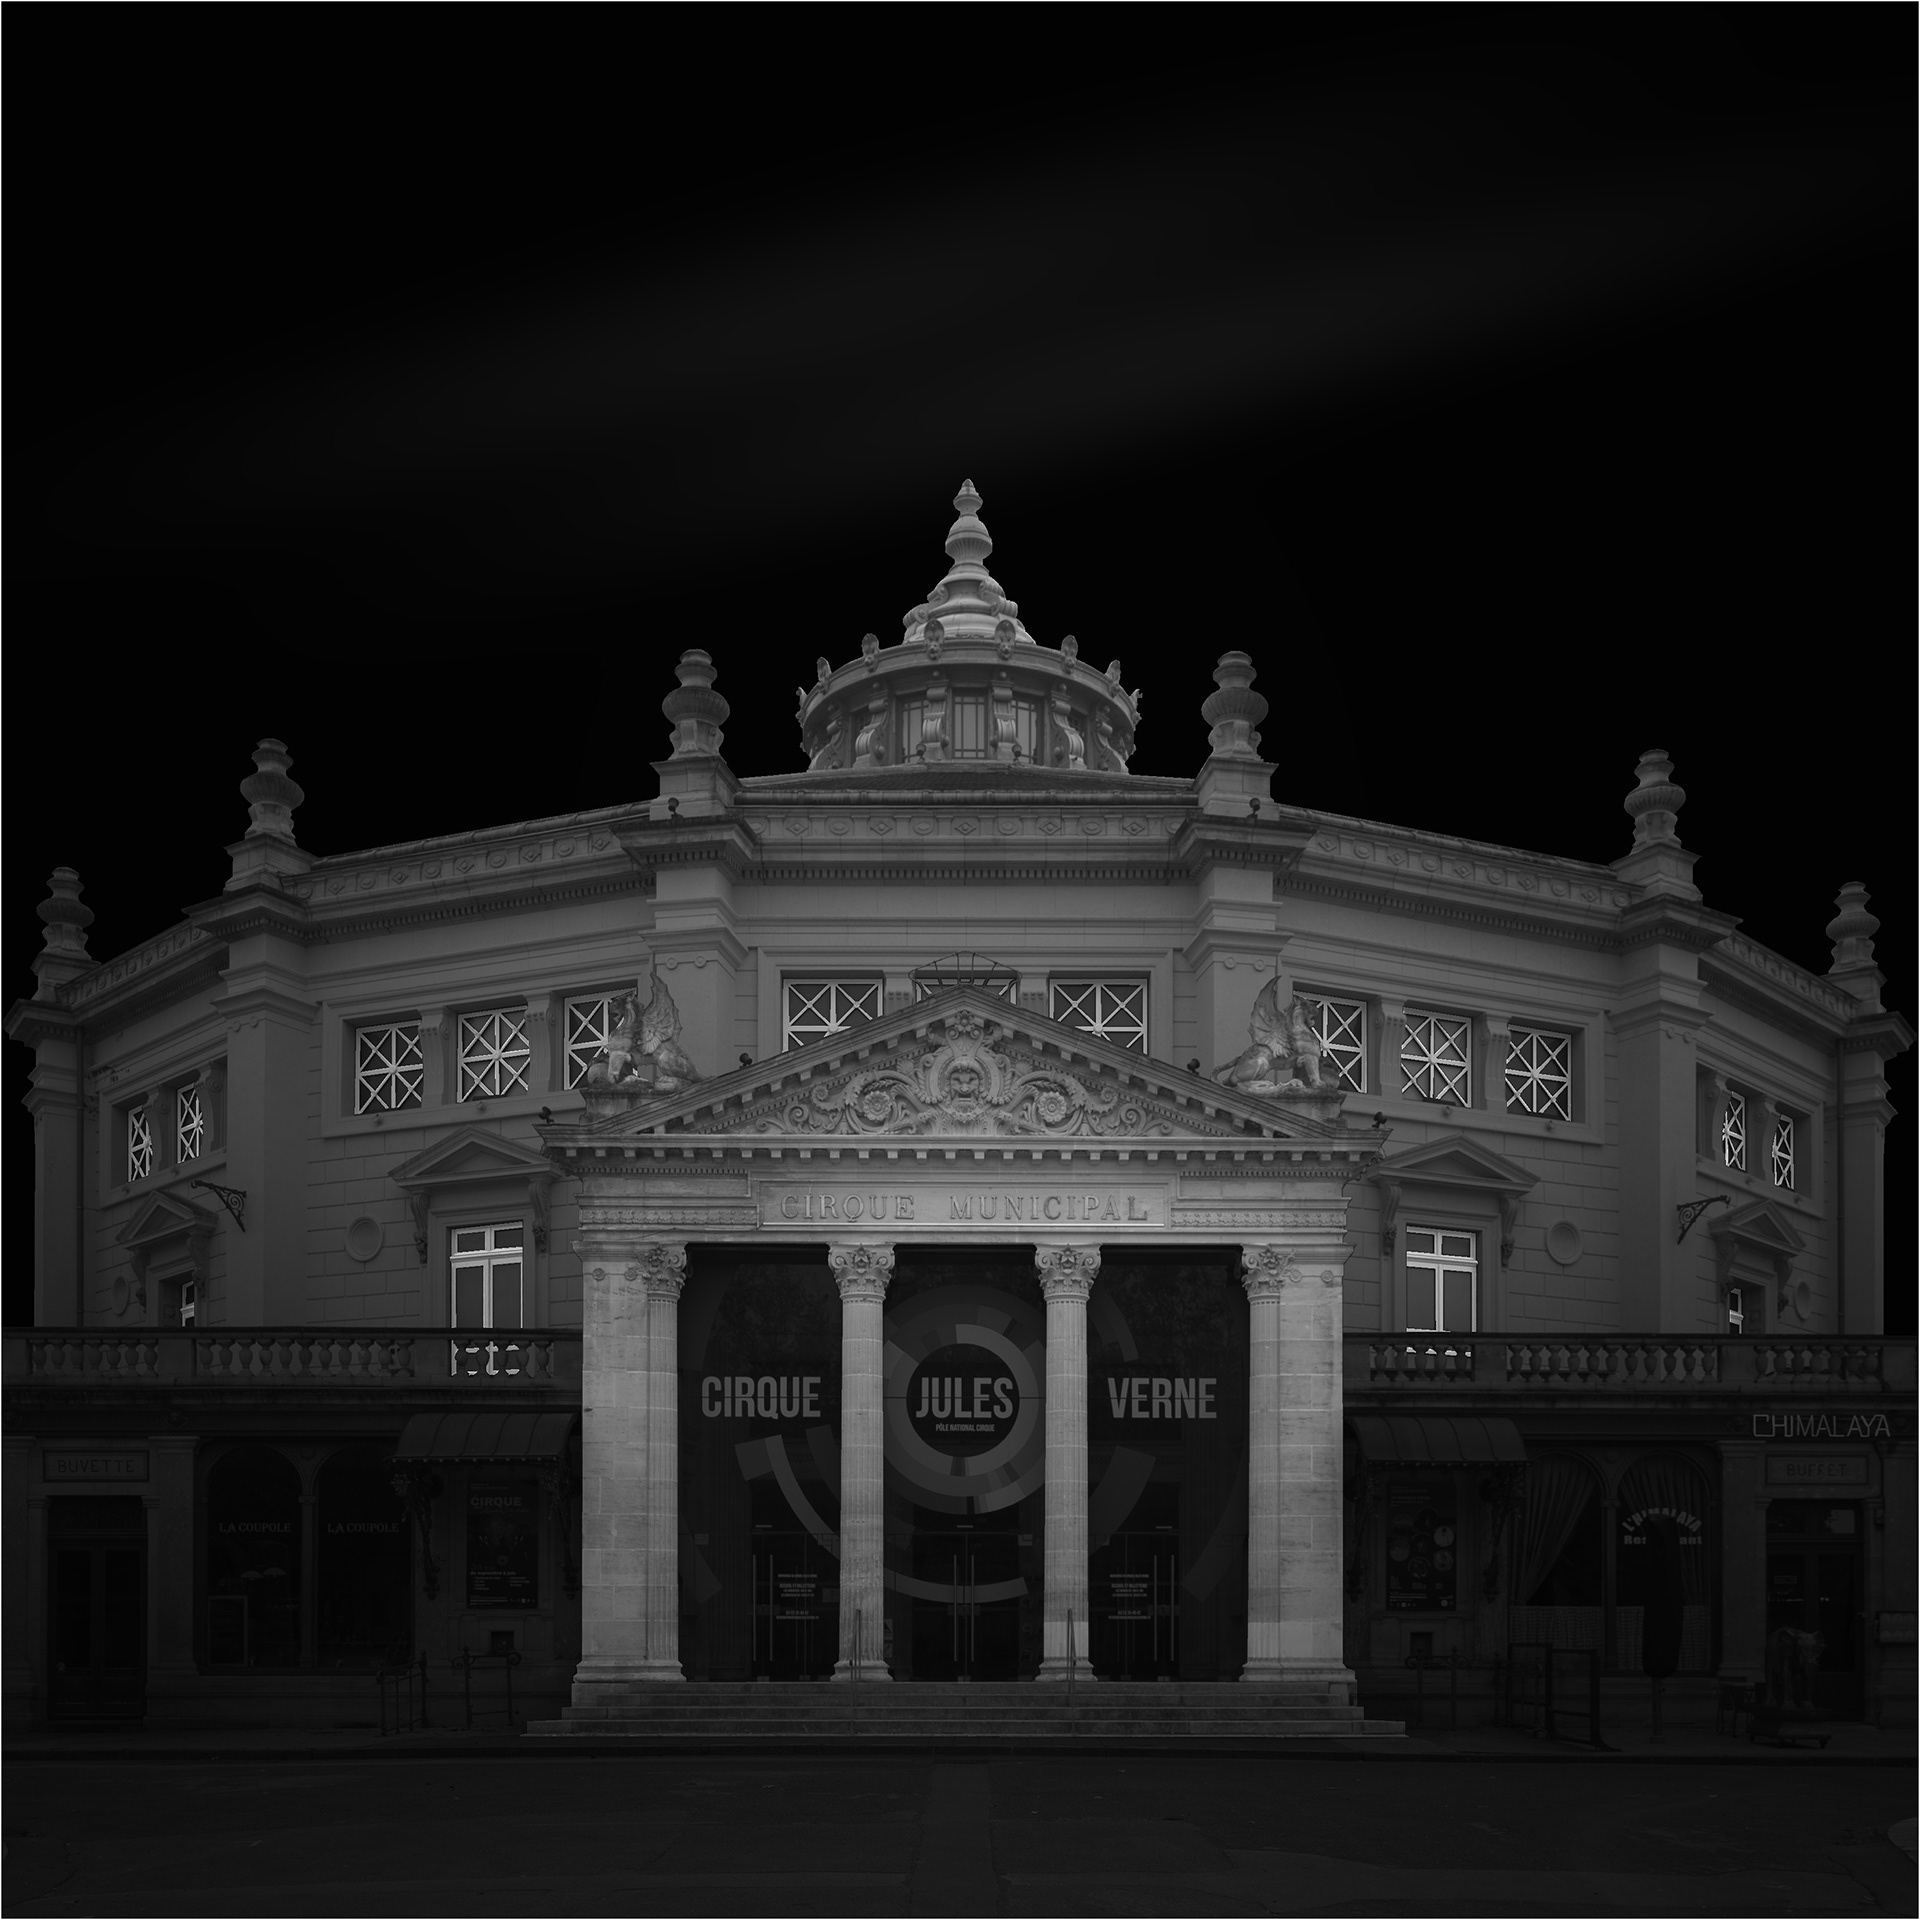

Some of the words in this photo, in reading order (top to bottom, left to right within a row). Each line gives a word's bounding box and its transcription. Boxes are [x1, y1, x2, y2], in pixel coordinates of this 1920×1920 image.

[780, 1194, 915, 1223] CIRQUE
[950, 1194, 1147, 1221] MUNICIPAL
[701, 1376, 821, 1420] CIRQUE
[915, 1376, 1014, 1420] JULES
[1107, 1377, 1218, 1419] VERNE
[935, 1423, 949, 1432] PÔLE
[950, 1423, 975, 1432] NATIONAL
[976, 1423, 995, 1432] CIRQUE
[57, 1459, 135, 1473] BUVETTE
[1786, 1463, 1848, 1477] BUFFET
[470, 1496, 522, 1508] CIRQUE
[219, 1522, 236, 1534] LA
[238, 1522, 292, 1533] COUPOLE
[327, 1522, 344, 1535] LA
[346, 1522, 400, 1533] COUPOLE
[1623, 1535, 1703, 1545] Resant
